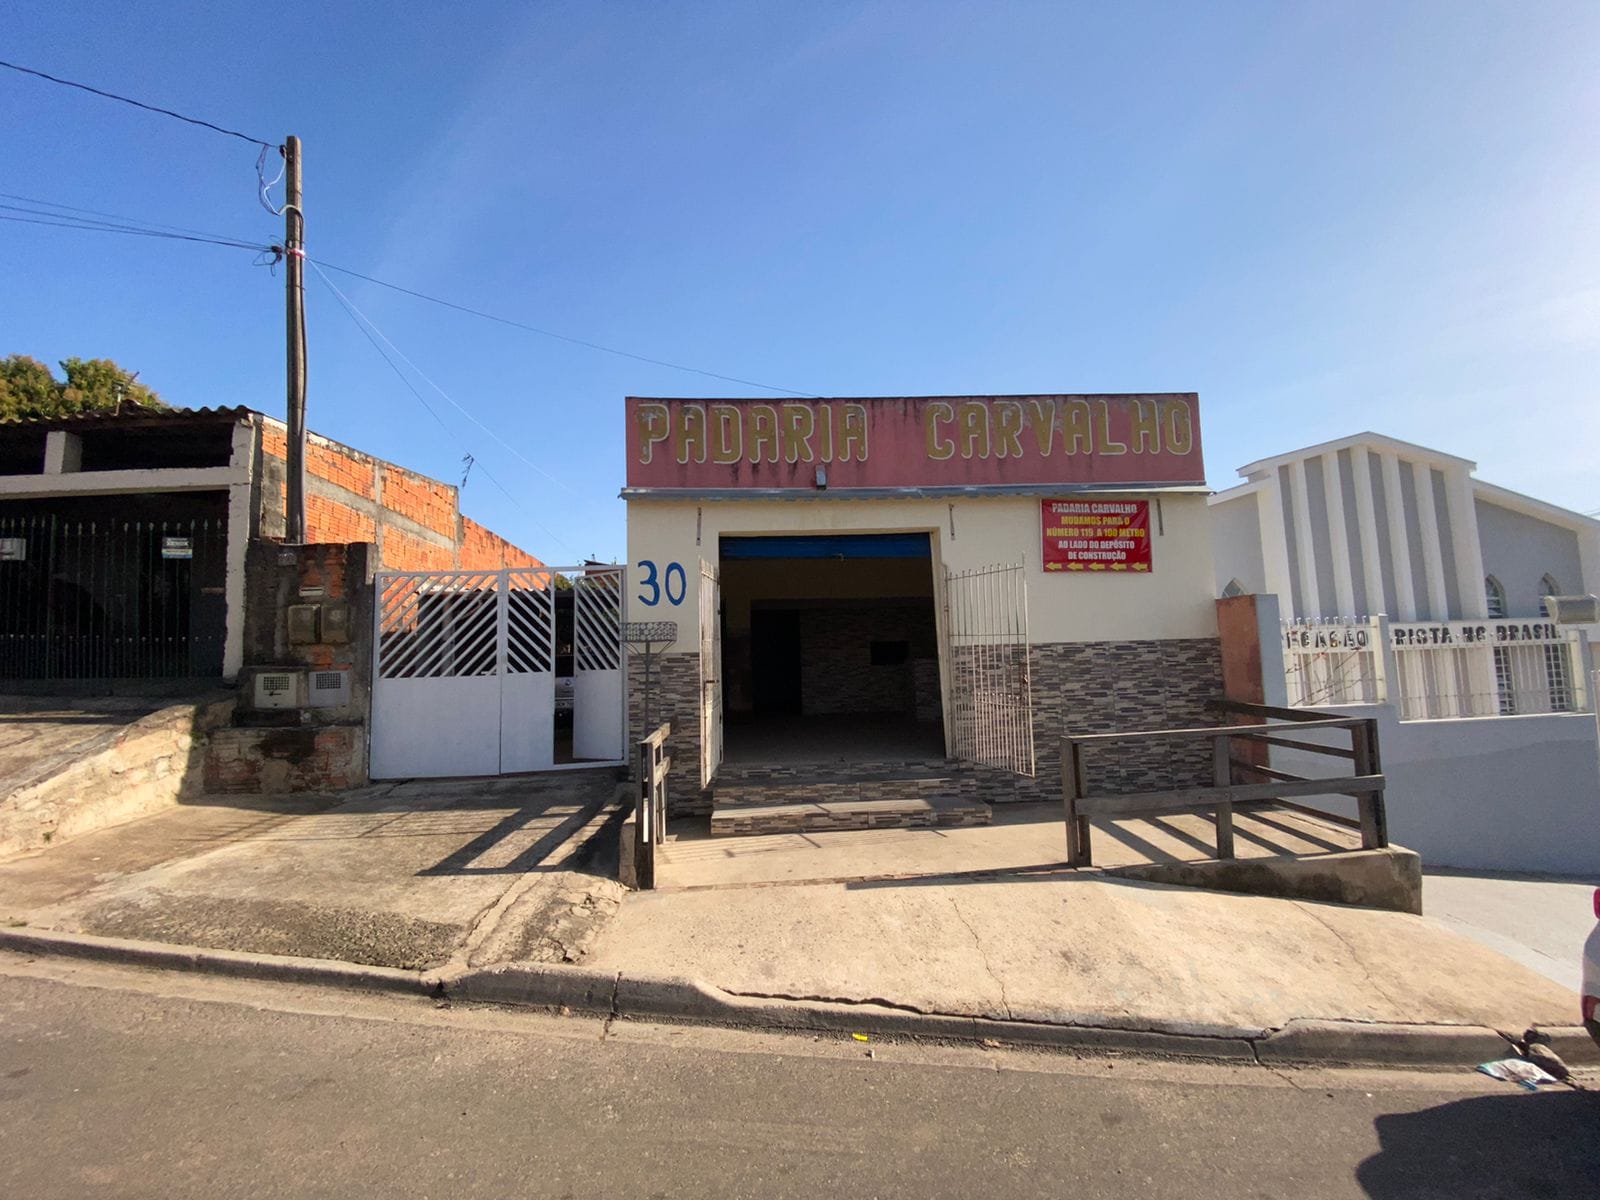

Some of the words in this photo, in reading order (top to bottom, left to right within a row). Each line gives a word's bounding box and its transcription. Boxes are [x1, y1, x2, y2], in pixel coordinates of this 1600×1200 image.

[637, 403, 869, 464] PADARIA
[926, 400, 1192, 460] CARVALHO
[1052, 503, 1090, 513] PADARIA
[1091, 503, 1137, 514] CARVALHO
[1061, 516, 1101, 525] MUDAMOS
[1103, 516, 1123, 525] PARA
[1124, 516, 1130, 525] O
[1046, 527, 1079, 537] NÚMERO
[1119, 528, 1145, 537] METRO
[1058, 540, 1068, 549] AO
[1070, 540, 1088, 549] LADO
[1089, 540, 1099, 549] DO
[1100, 539, 1135, 549] DEPÓSITO
[1068, 551, 1078, 560] DE
[1078, 550, 1126, 561] CONSTRUÇÃO
[638, 560, 686, 606] 30
